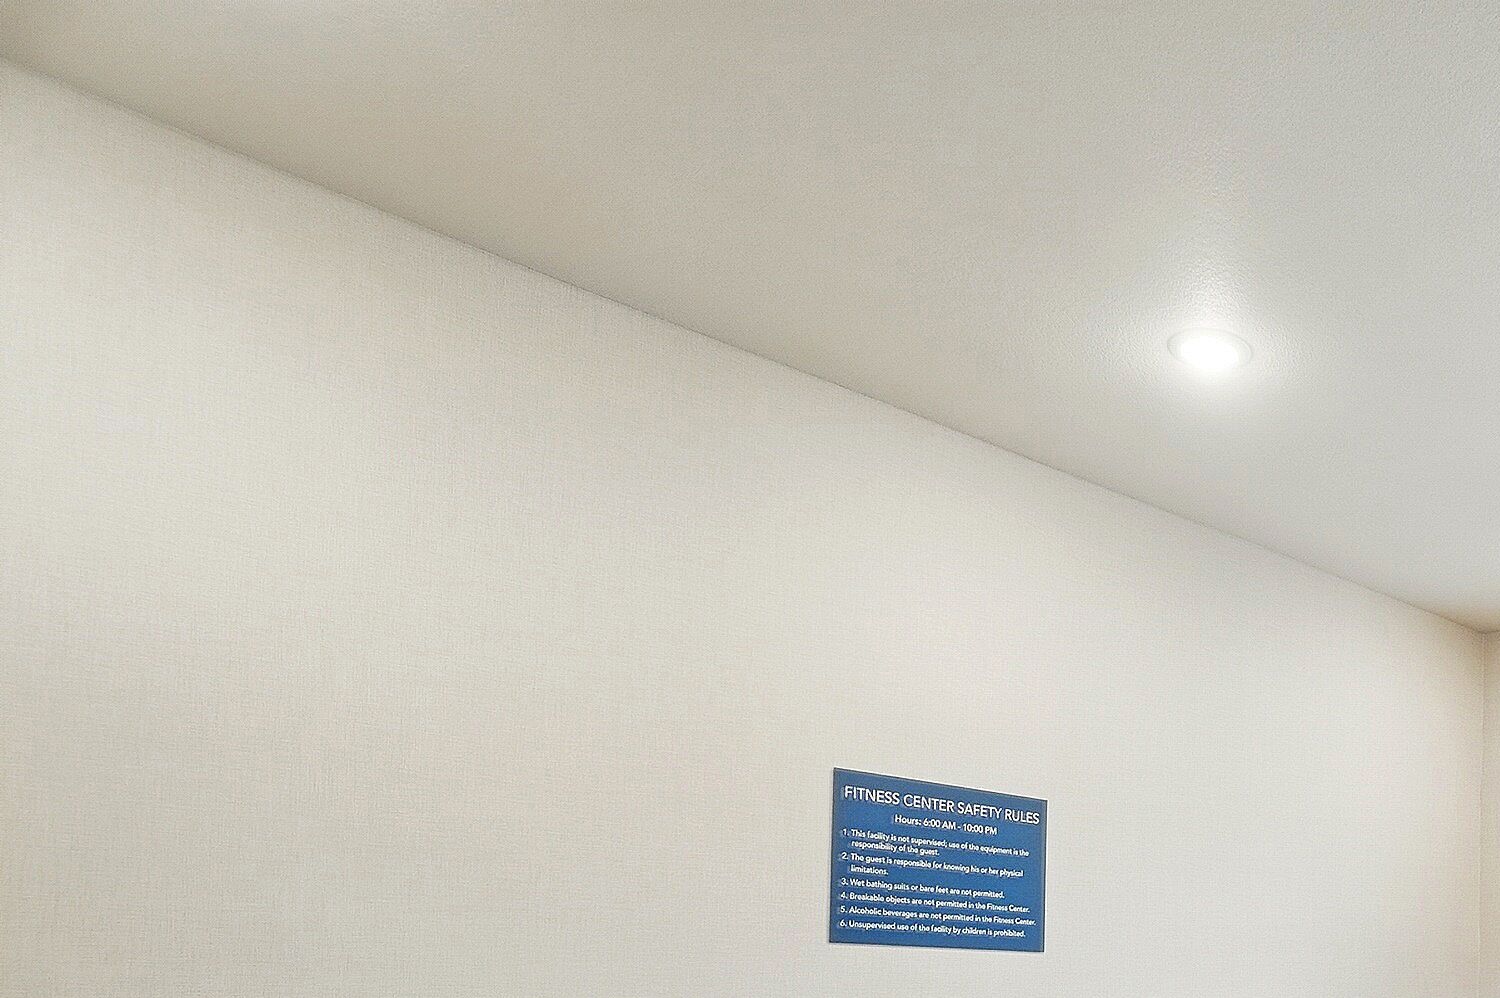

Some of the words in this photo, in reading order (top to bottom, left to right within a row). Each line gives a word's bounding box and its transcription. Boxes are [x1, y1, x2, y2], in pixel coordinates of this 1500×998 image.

[844, 786, 900, 804] FITNESS
[904, 794, 954, 812] CENTER
[958, 802, 1002, 818] SAFETY
[1005, 809, 1040, 824] RULES
[895, 814, 921, 825] Hours:
[923, 818, 940, 827] 6:00
[942, 821, 956, 830] AM
[963, 824, 983, 833] 10:00
[985, 826, 997, 835] PM
[851, 829, 866, 838] This
[867, 831, 890, 842] facility
[980, 846, 1012, 854] equipment
[851, 841, 897, 852] responsibility
[851, 853, 864, 861] The
[894, 859, 931, 868] responsible
[943, 862, 969, 873] knowing
[1000, 869, 1023, 877] physical
[866, 880, 892, 890] bathing
[920, 884, 934, 892] bare
[850, 892, 884, 901] Breakable
[886, 896, 910, 904] objects
[987, 903, 1008, 911] Fitness
[849, 906, 881, 915] Alcoholic
[883, 908, 917, 918] beverages
[849, 920, 895, 930] Unsupervised
[910, 923, 918, 931] of
[918, 923, 930, 932] the
[931, 924, 952, 934] facility
[953, 926, 961, 934] by
